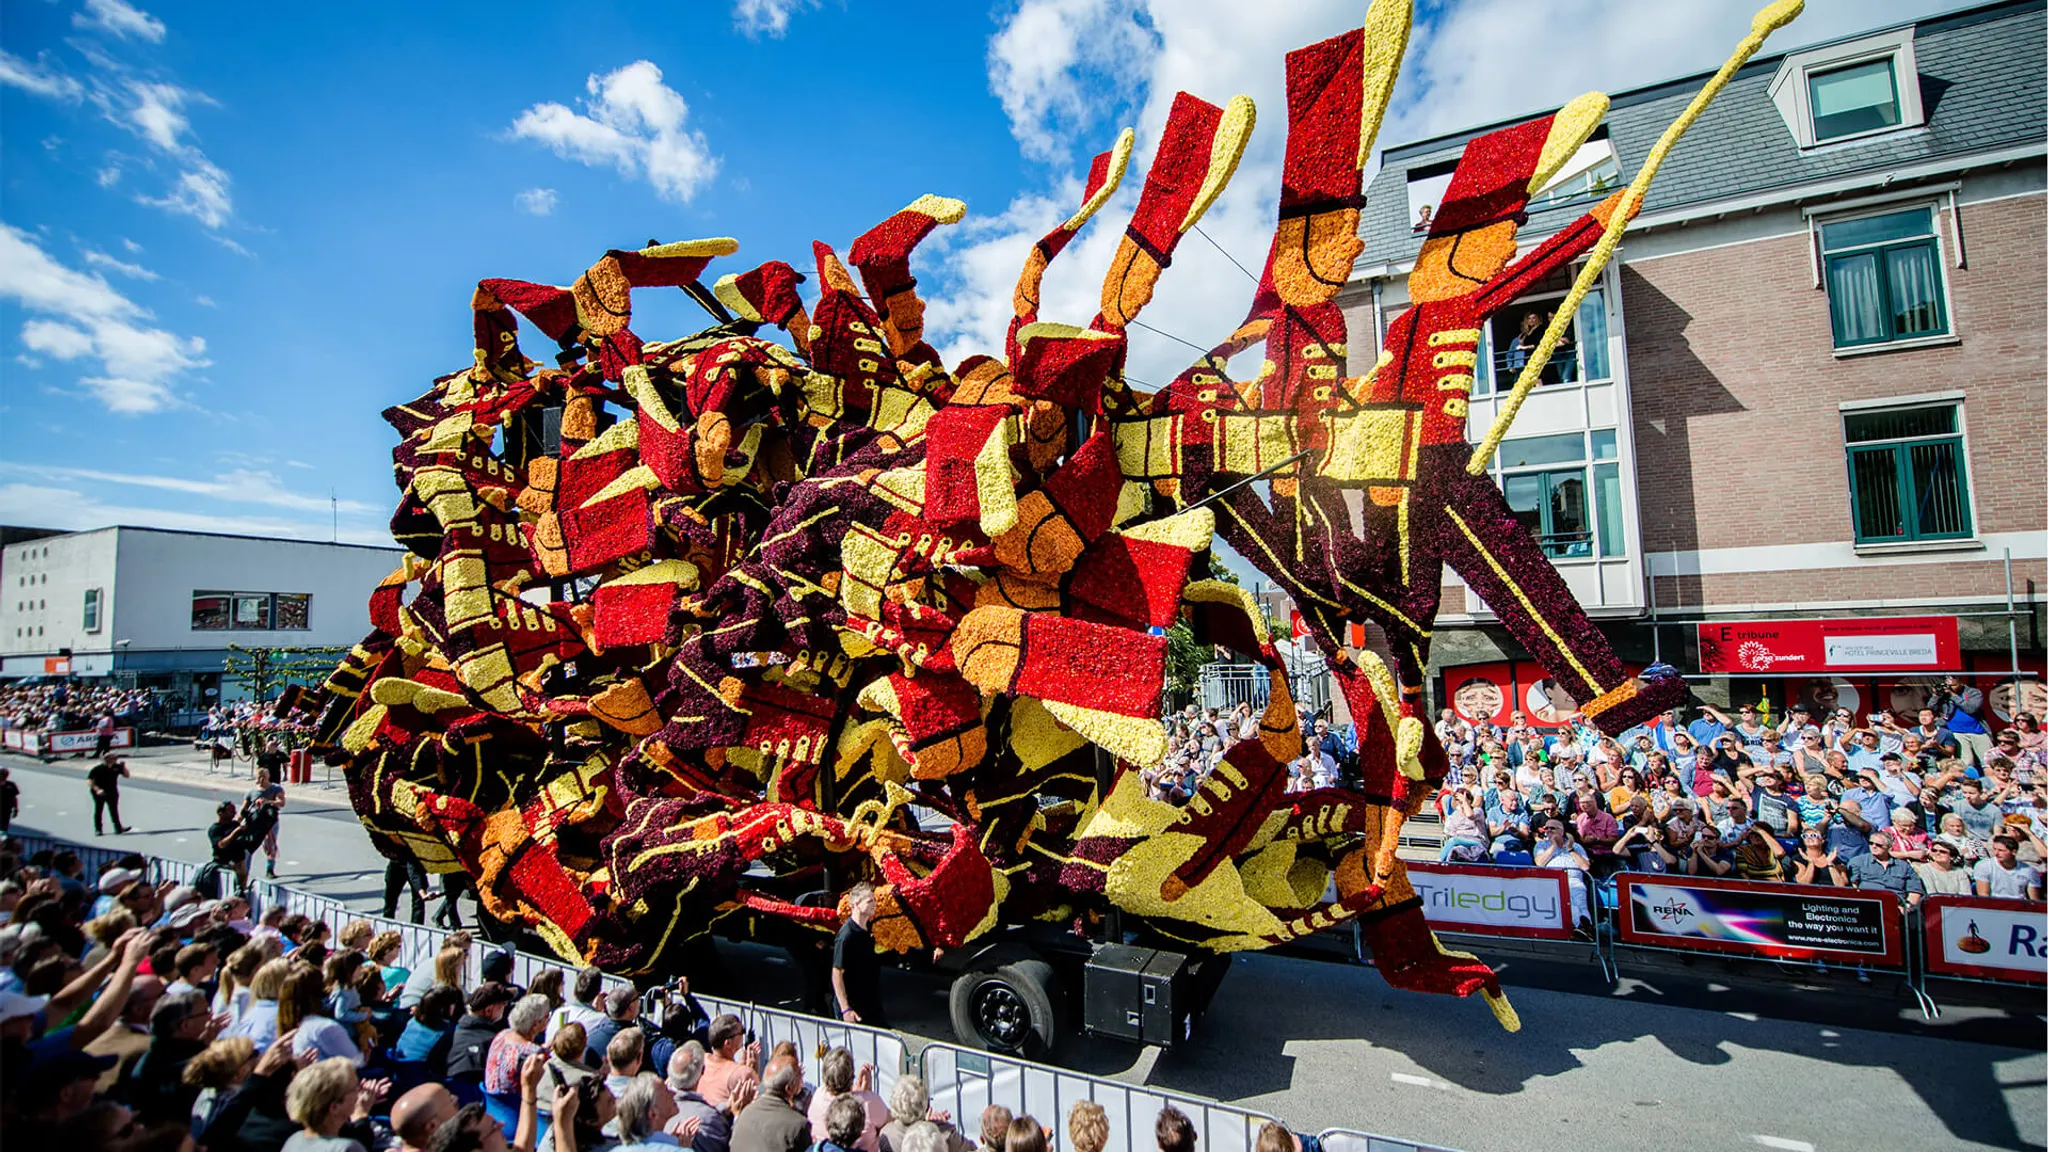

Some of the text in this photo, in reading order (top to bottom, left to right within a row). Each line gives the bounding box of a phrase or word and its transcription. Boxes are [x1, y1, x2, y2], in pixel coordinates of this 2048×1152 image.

[1721, 626, 1779, 641] E tribune
[1909, 648, 1932, 656] BREDA
[1412, 883, 1557, 920] Triledgy
[1653, 906, 1694, 916] RENA
[1802, 903, 1839, 915] Lighting
[1805, 912, 1857, 923] Electronics
[1788, 920, 1878, 934] the way you want it
